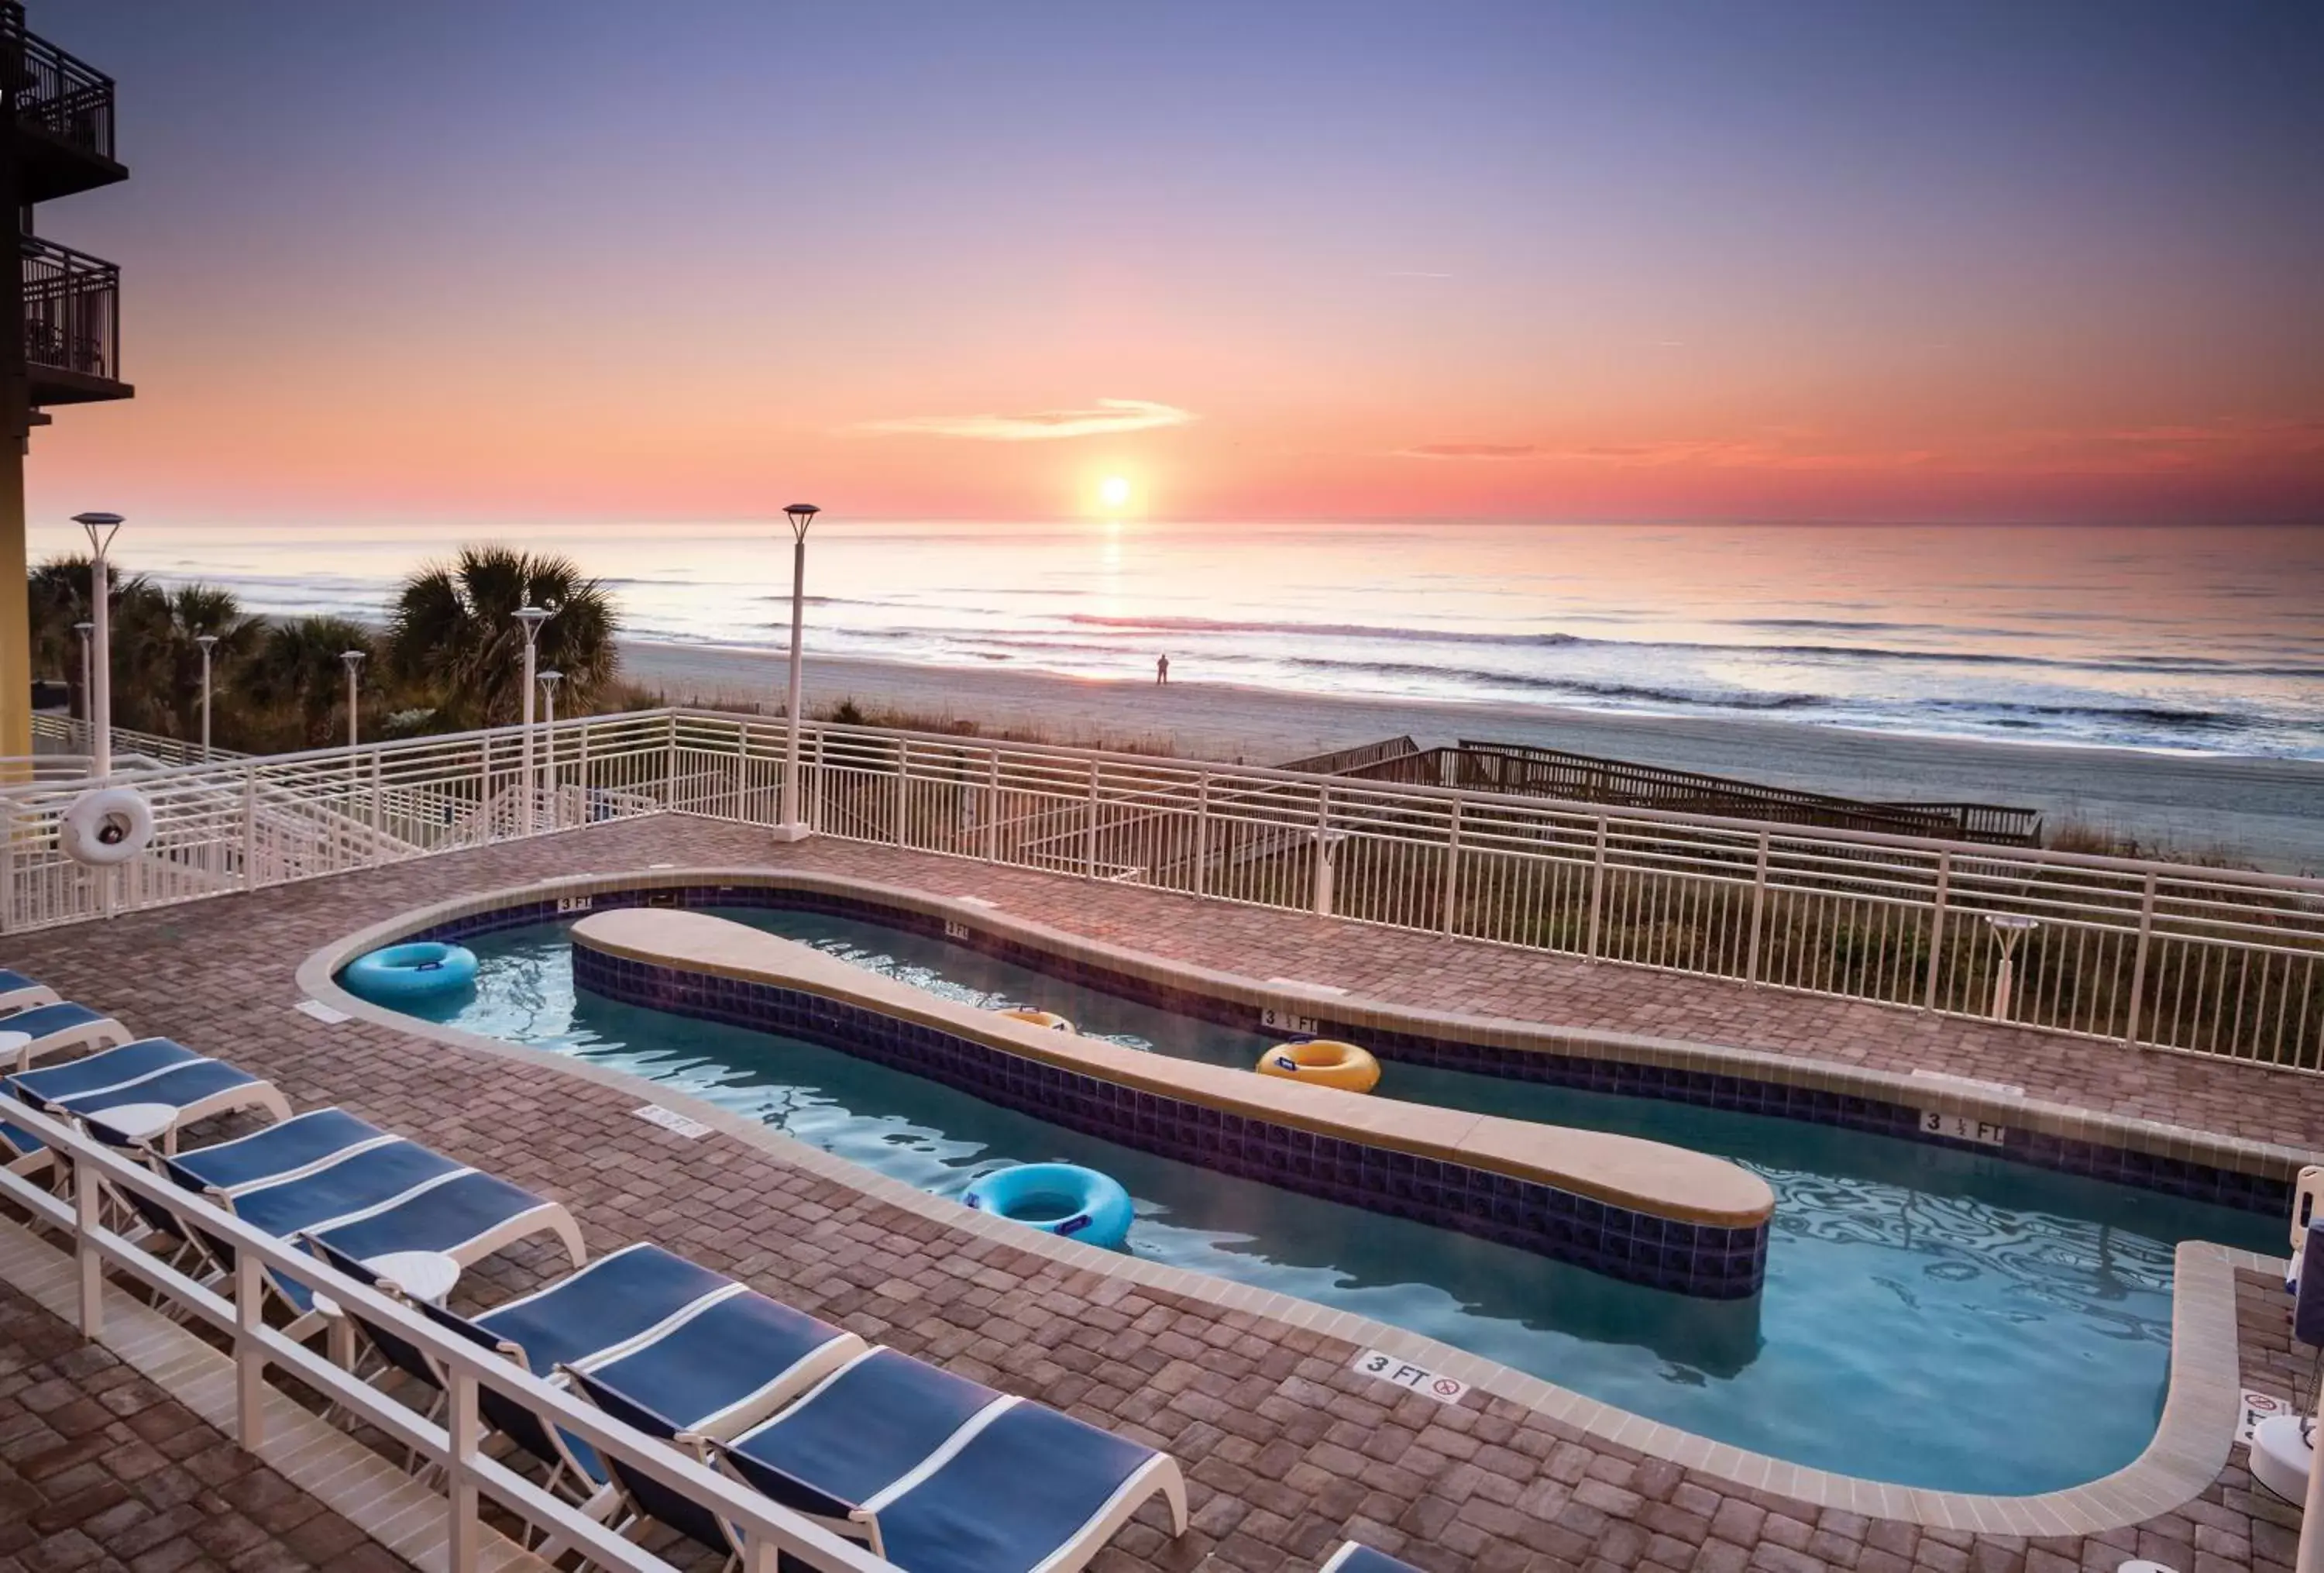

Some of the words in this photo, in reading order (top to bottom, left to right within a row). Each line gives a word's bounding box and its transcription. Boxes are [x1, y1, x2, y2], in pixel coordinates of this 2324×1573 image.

[562, 898, 569, 910] 3
[1266, 1009, 1275, 1024] 3
[1927, 1113, 1941, 1130] 3
[1367, 1357, 1389, 1372] 3
[1392, 1365, 1430, 1386] FT
